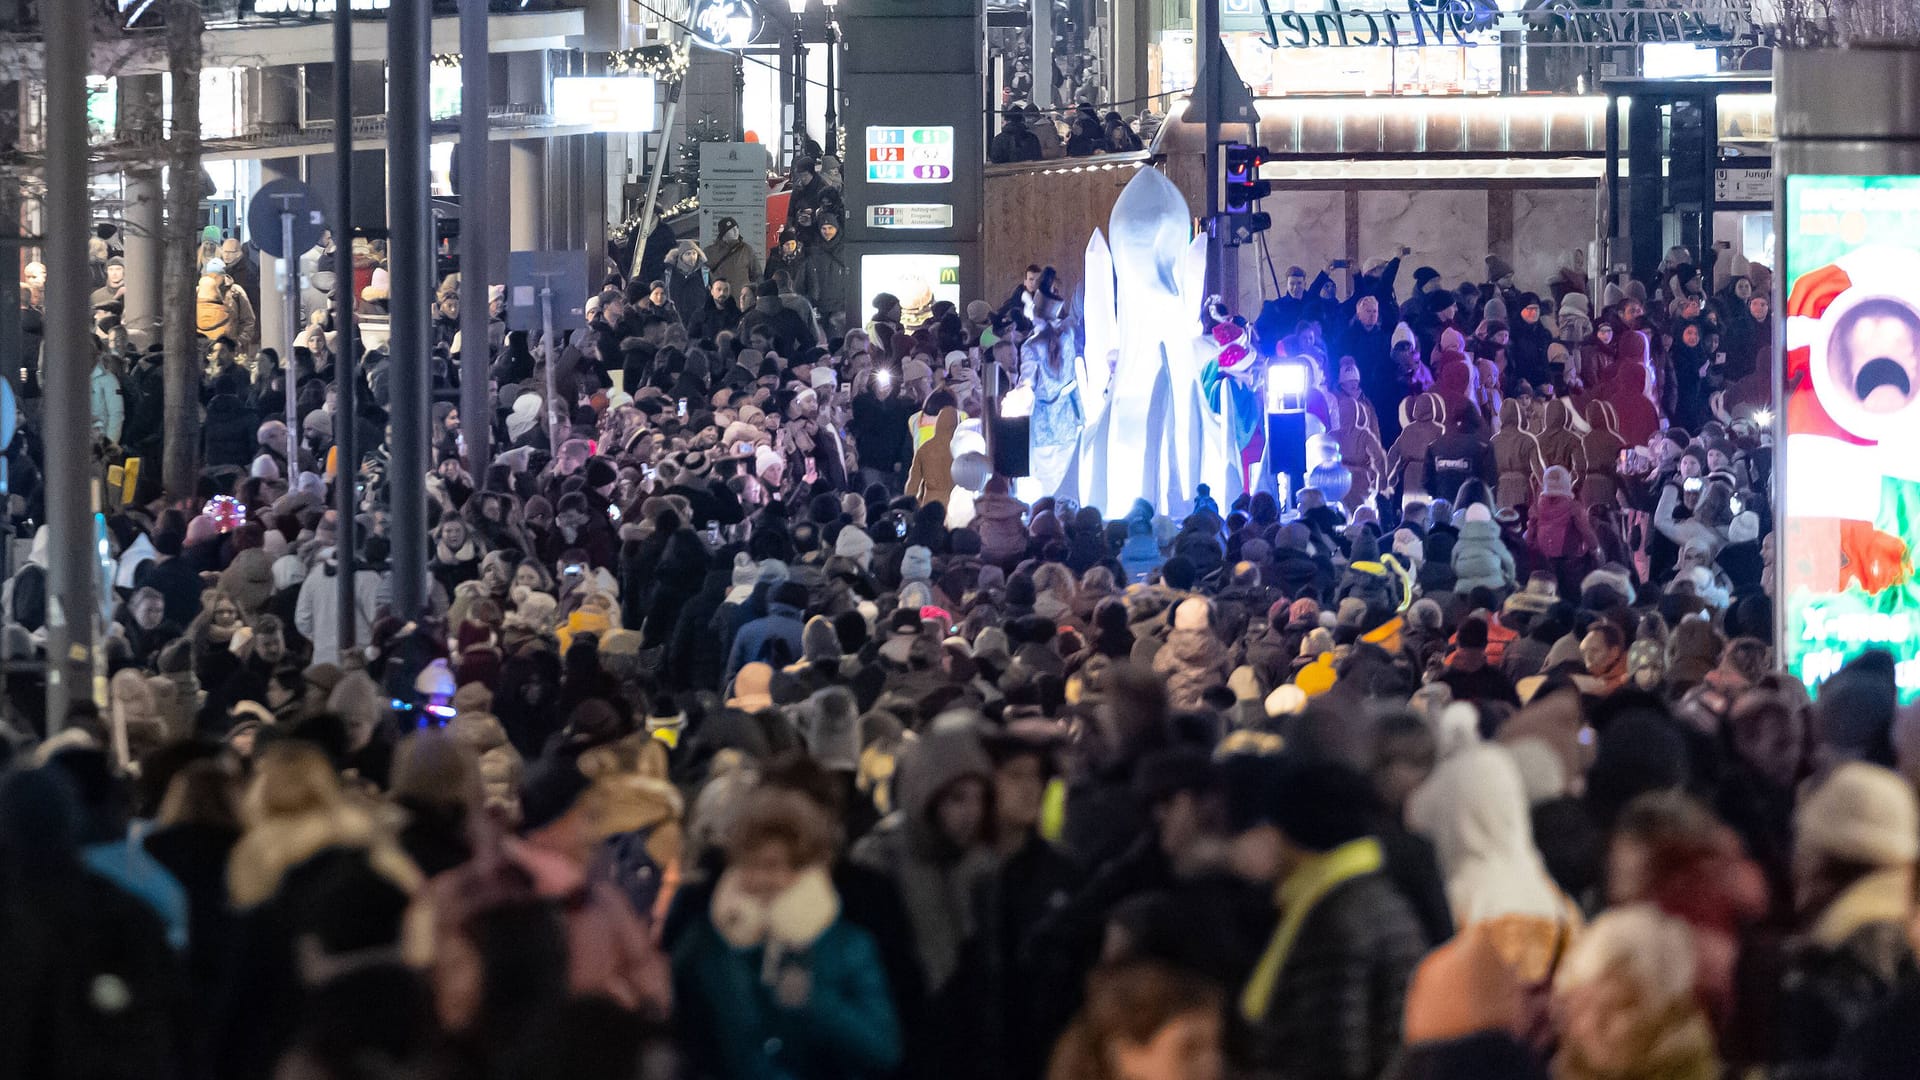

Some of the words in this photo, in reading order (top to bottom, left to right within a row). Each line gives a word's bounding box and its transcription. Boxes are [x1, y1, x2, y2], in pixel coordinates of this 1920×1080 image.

[877, 130, 896, 144] U1
[877, 148, 897, 161] U2
[877, 165, 897, 178] U4
[878, 207, 891, 215] U2
